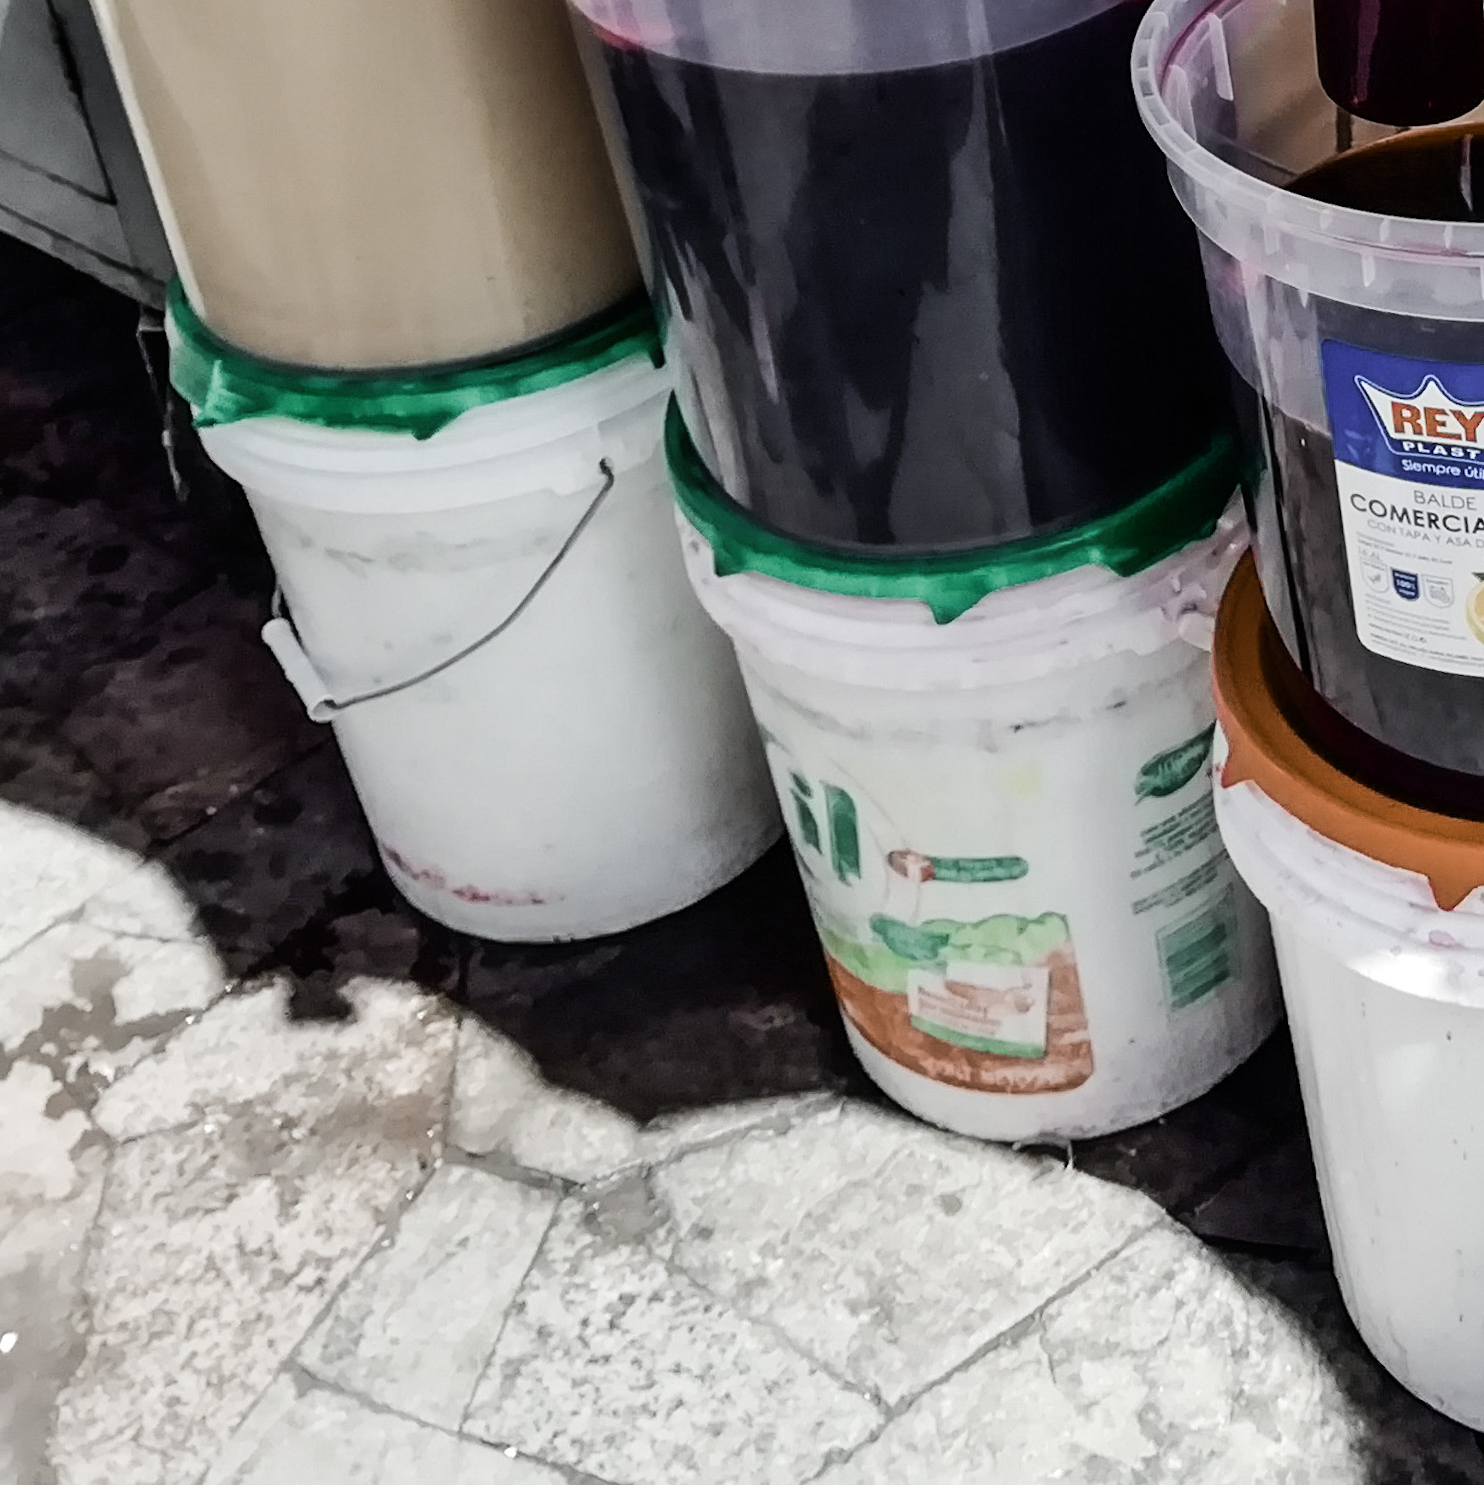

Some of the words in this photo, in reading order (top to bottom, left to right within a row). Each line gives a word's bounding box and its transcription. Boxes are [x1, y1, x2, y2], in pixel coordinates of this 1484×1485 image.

[1402, 441, 1481, 459] PLAST
[1413, 489, 1477, 511] BALDE
[1367, 519, 1397, 534] CON
[1398, 526, 1432, 542] TAPA
[1446, 537, 1472, 548] ASA
